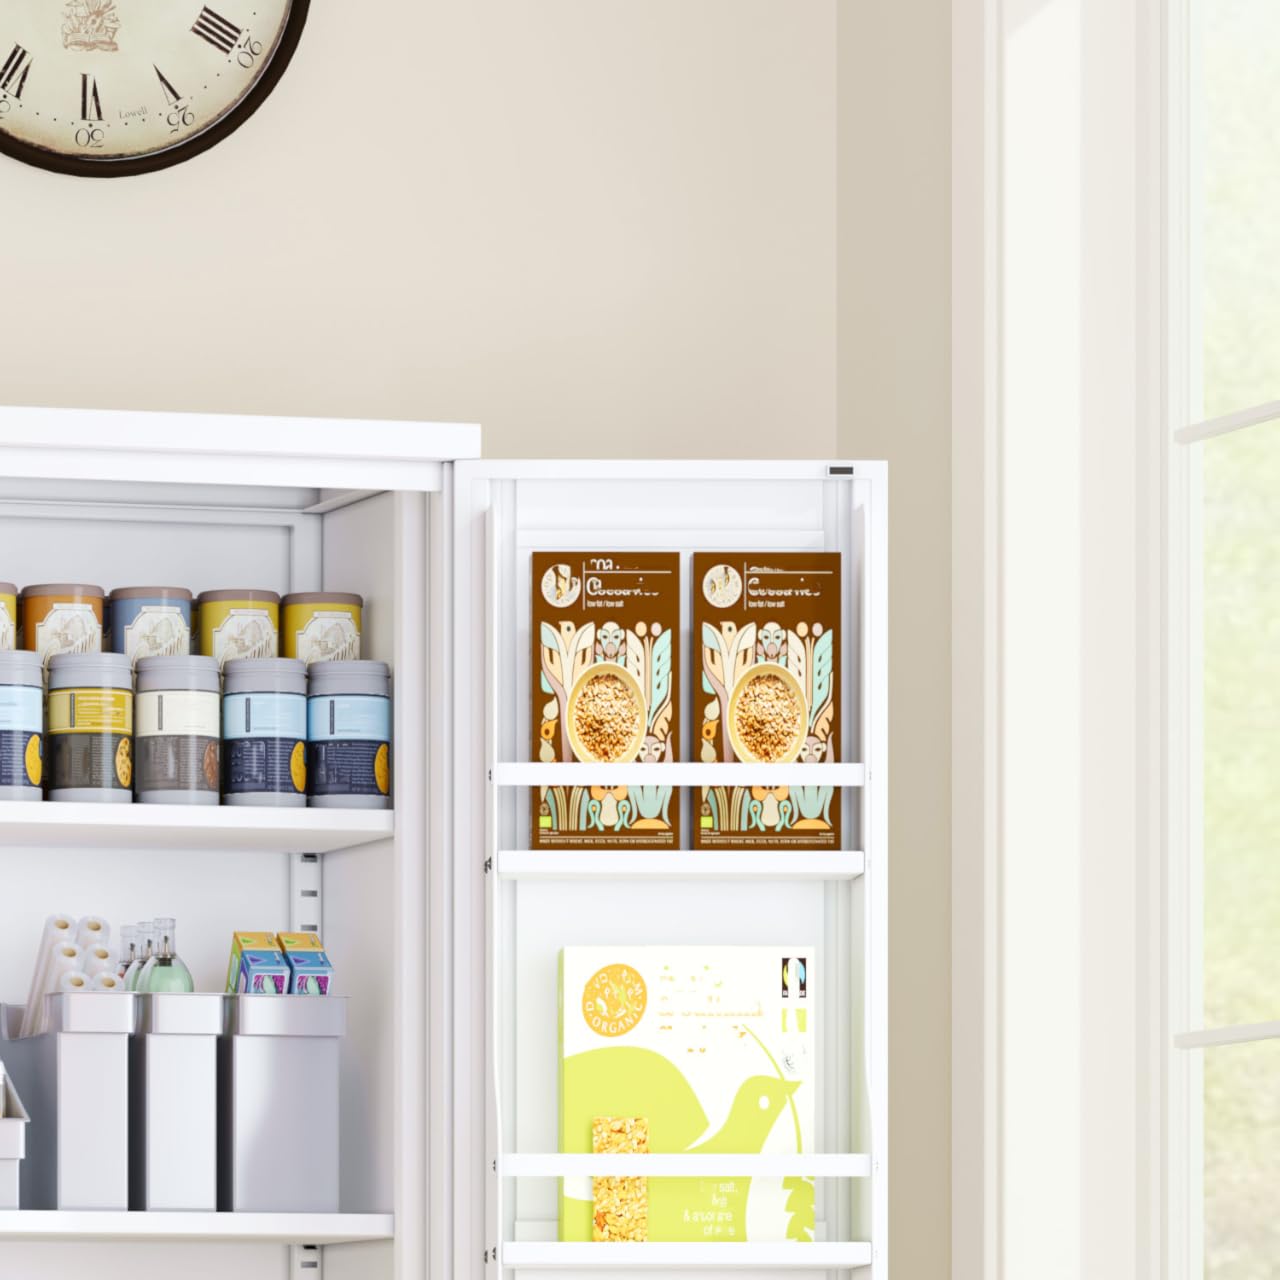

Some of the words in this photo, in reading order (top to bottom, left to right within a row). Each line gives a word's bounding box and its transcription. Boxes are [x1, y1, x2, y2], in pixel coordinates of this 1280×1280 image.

[237, 36, 263, 69] 20
[166, 105, 195, 134] 25
[75, 128, 105, 148] 30
